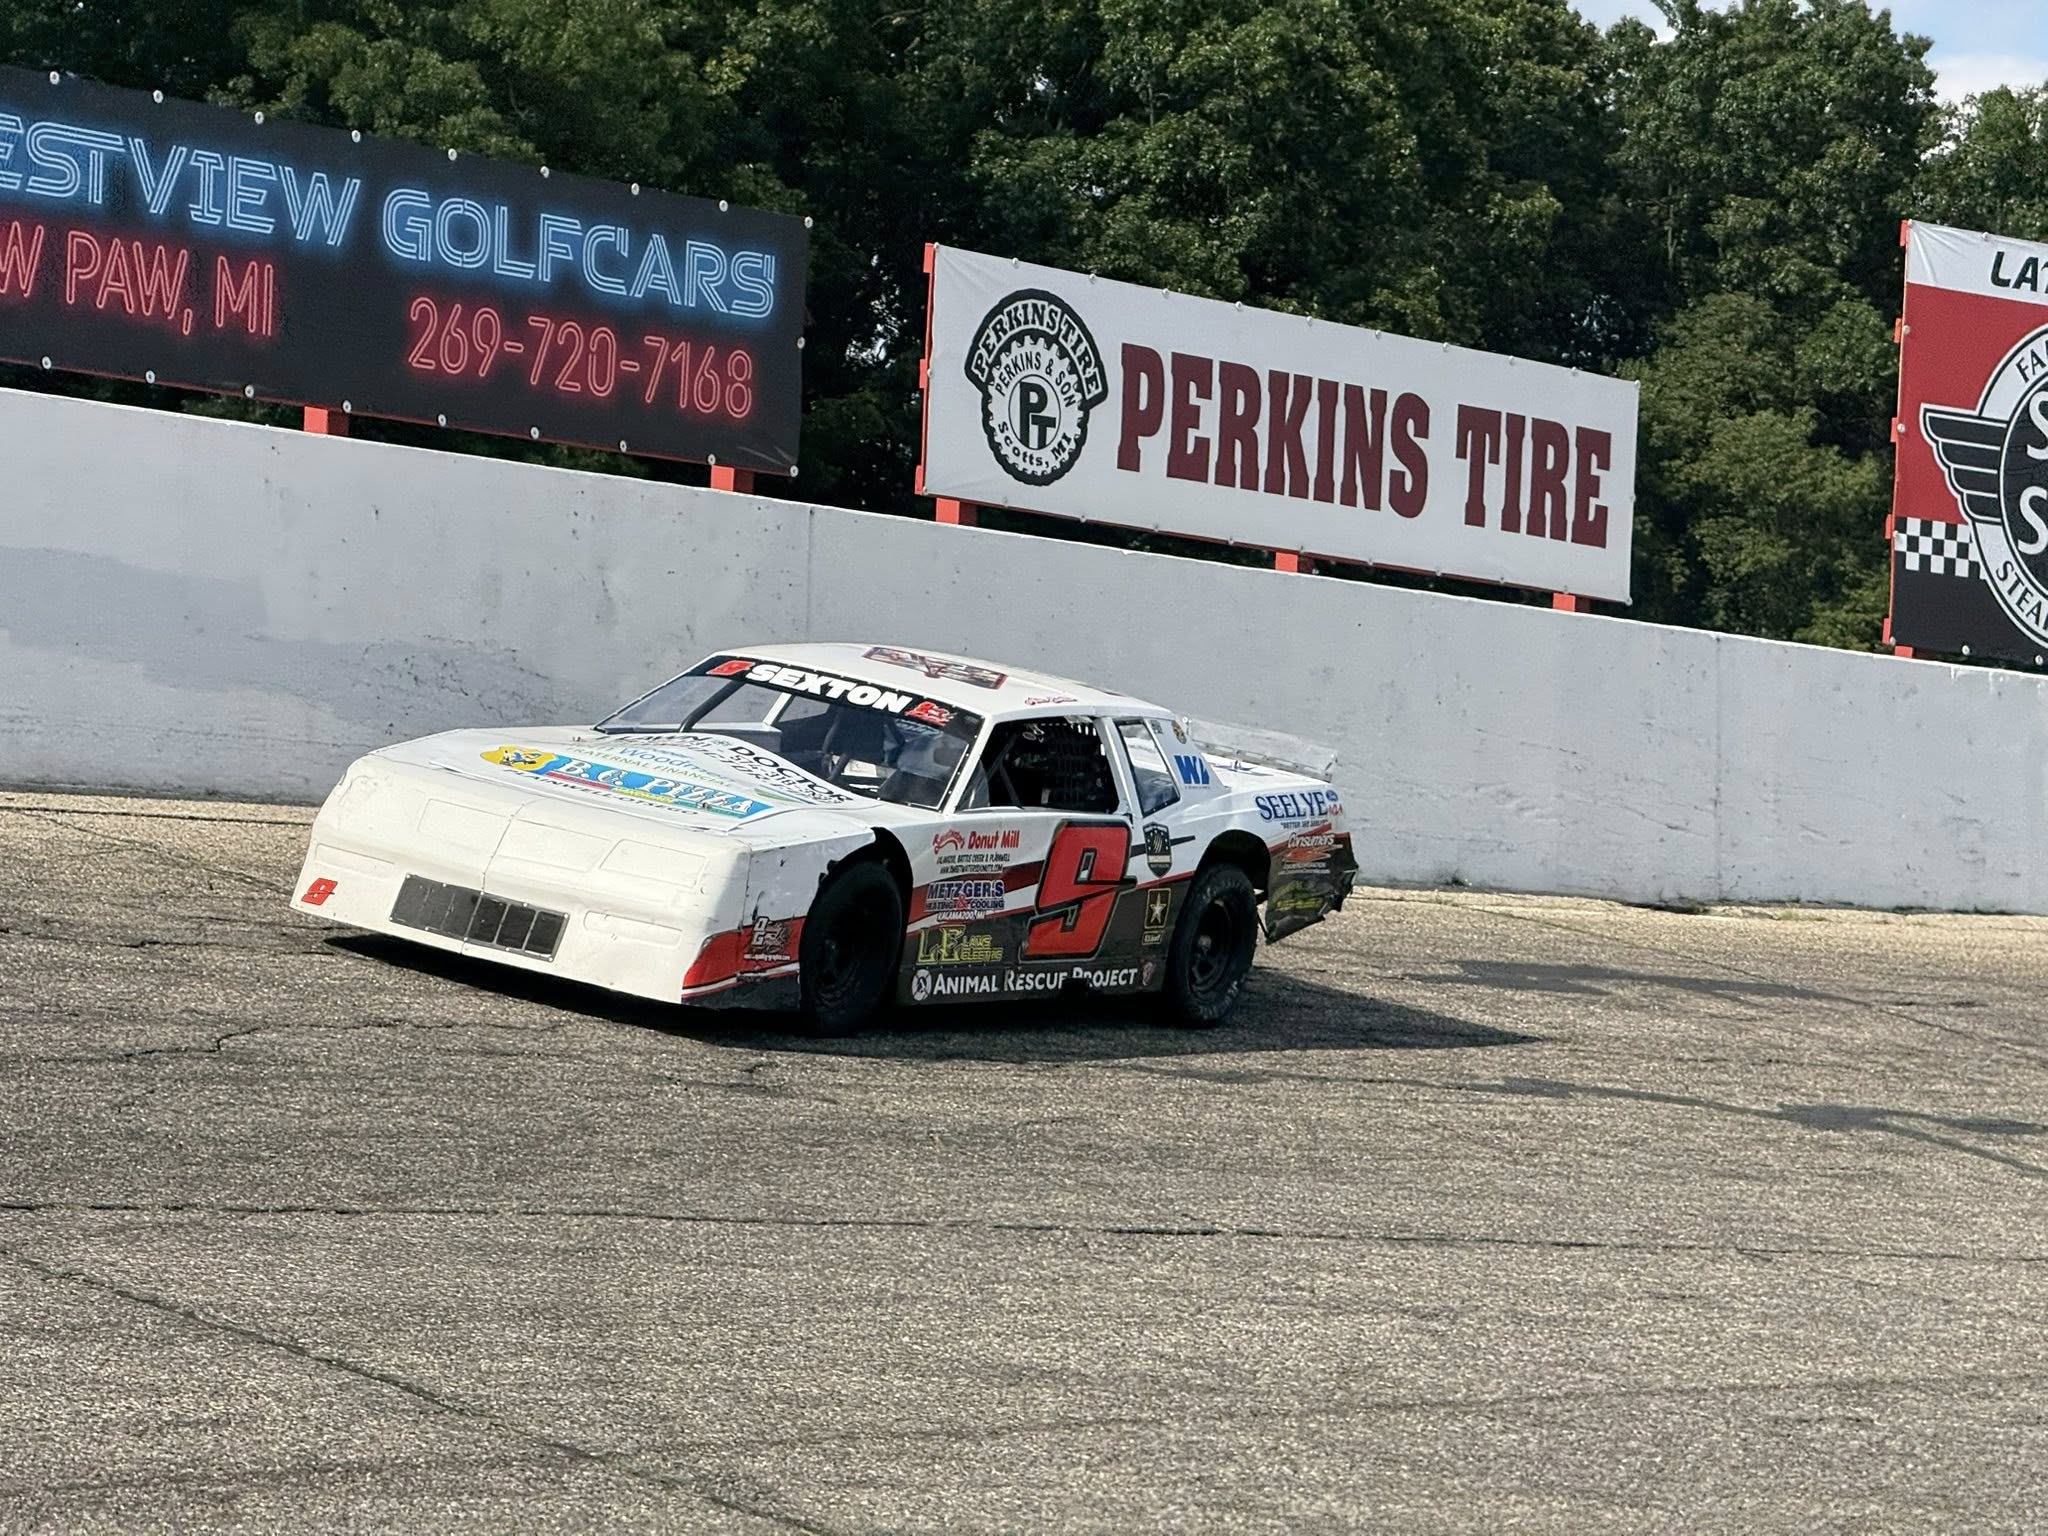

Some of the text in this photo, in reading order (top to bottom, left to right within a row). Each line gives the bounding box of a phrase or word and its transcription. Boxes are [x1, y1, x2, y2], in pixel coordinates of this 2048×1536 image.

[382, 188, 776, 319] GOLFCARS
[66, 230, 193, 336] PAW,
[215, 256, 274, 337] MI
[408, 297, 753, 419] 269-720-7168
[973, 302, 1100, 396] PERKINS TIRE
[2016, 340, 2048, 383] FA
[995, 351, 1076, 408] PERKINS & SON
[998, 421, 1072, 468] Scotts, MI
[1116, 342, 1612, 549] PERKINS TIRE
[745, 664, 912, 713] SEXTON
[640, 778, 754, 813] PIZZA
[1255, 791, 1328, 820] SEELYE
[968, 829, 999, 850] Donut
[1001, 829, 1021, 849] Mill
[927, 881, 1004, 899] METZGER'S
[970, 898, 1005, 910] COOLING
[1019, 819, 1137, 963] 9
[933, 973, 999, 995] ANIMAL
